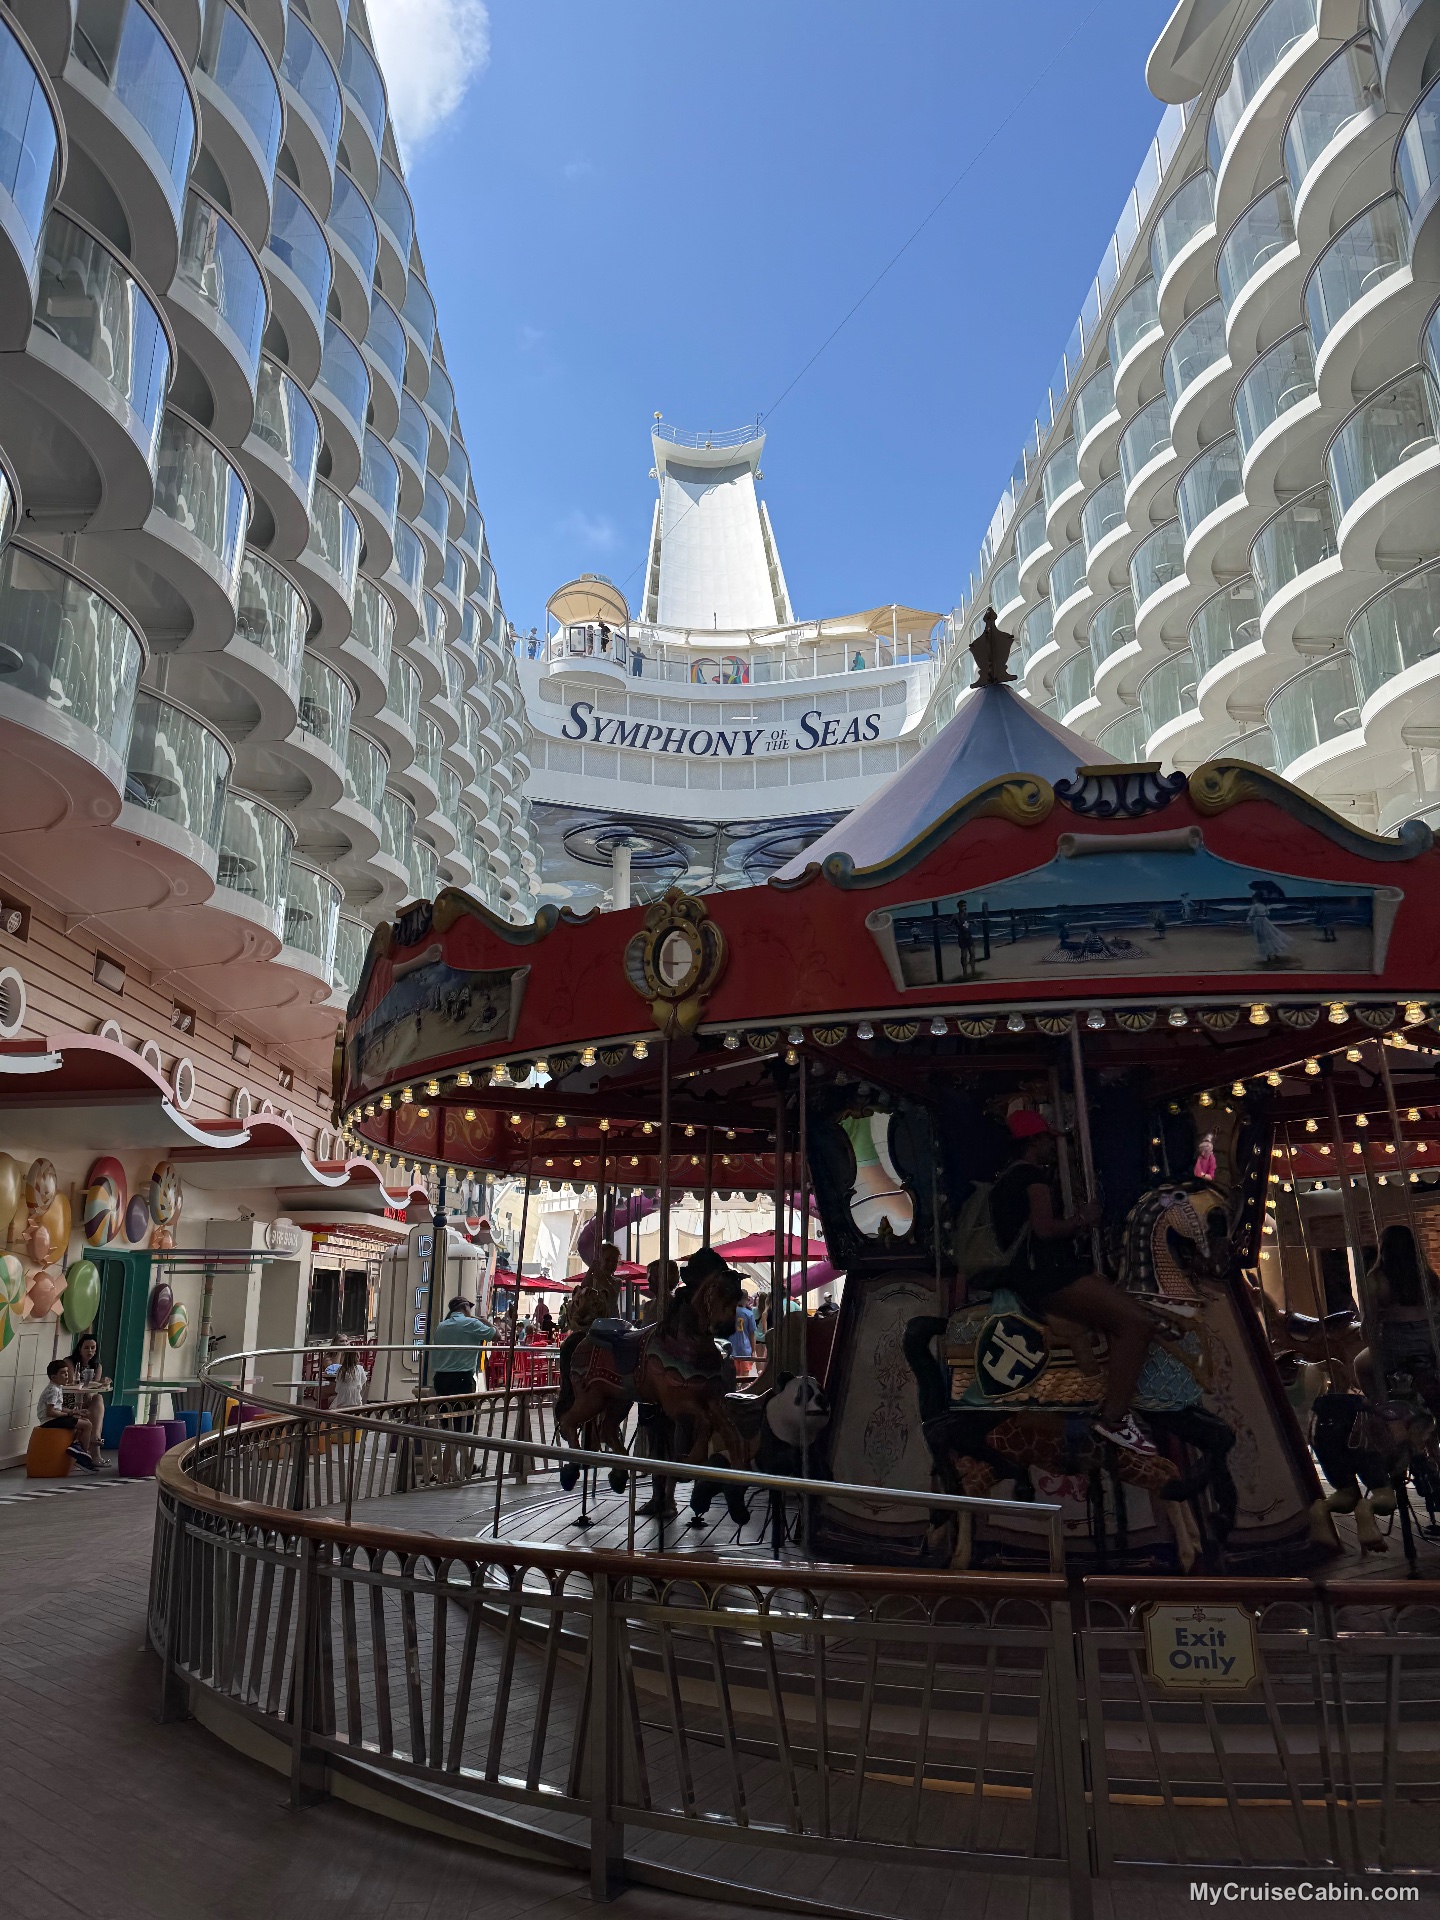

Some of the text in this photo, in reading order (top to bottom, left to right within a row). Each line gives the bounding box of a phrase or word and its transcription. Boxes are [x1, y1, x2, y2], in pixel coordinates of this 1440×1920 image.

[561, 701, 881, 757] SYMPHONY OF THE SEAS
[1175, 1627, 1226, 1647] Exit
[1169, 1649, 1236, 1675] Only
